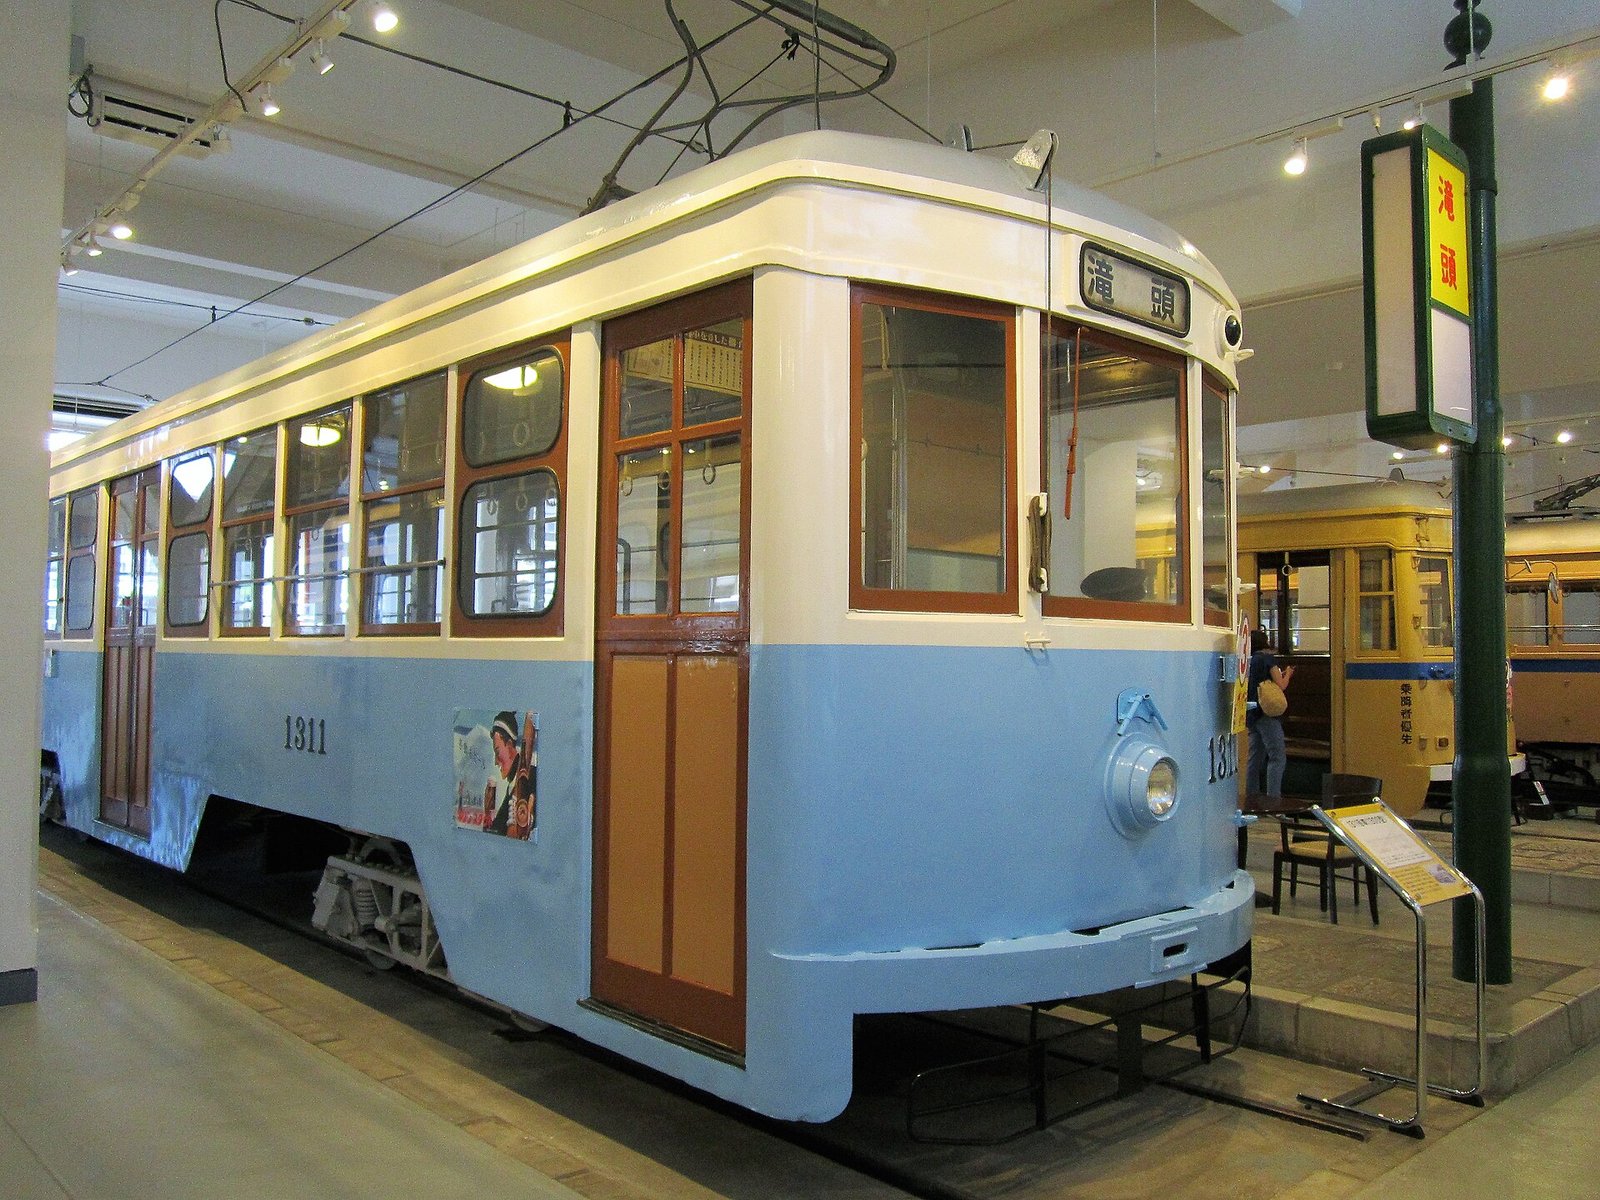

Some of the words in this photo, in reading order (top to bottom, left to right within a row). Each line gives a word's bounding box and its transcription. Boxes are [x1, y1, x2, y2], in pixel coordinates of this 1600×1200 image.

[1438, 175, 1457, 291] 滝頭
[1087, 254, 1176, 324] 滝頭
[284, 715, 327, 755] 1311
[1208, 734, 1239, 784] 131
